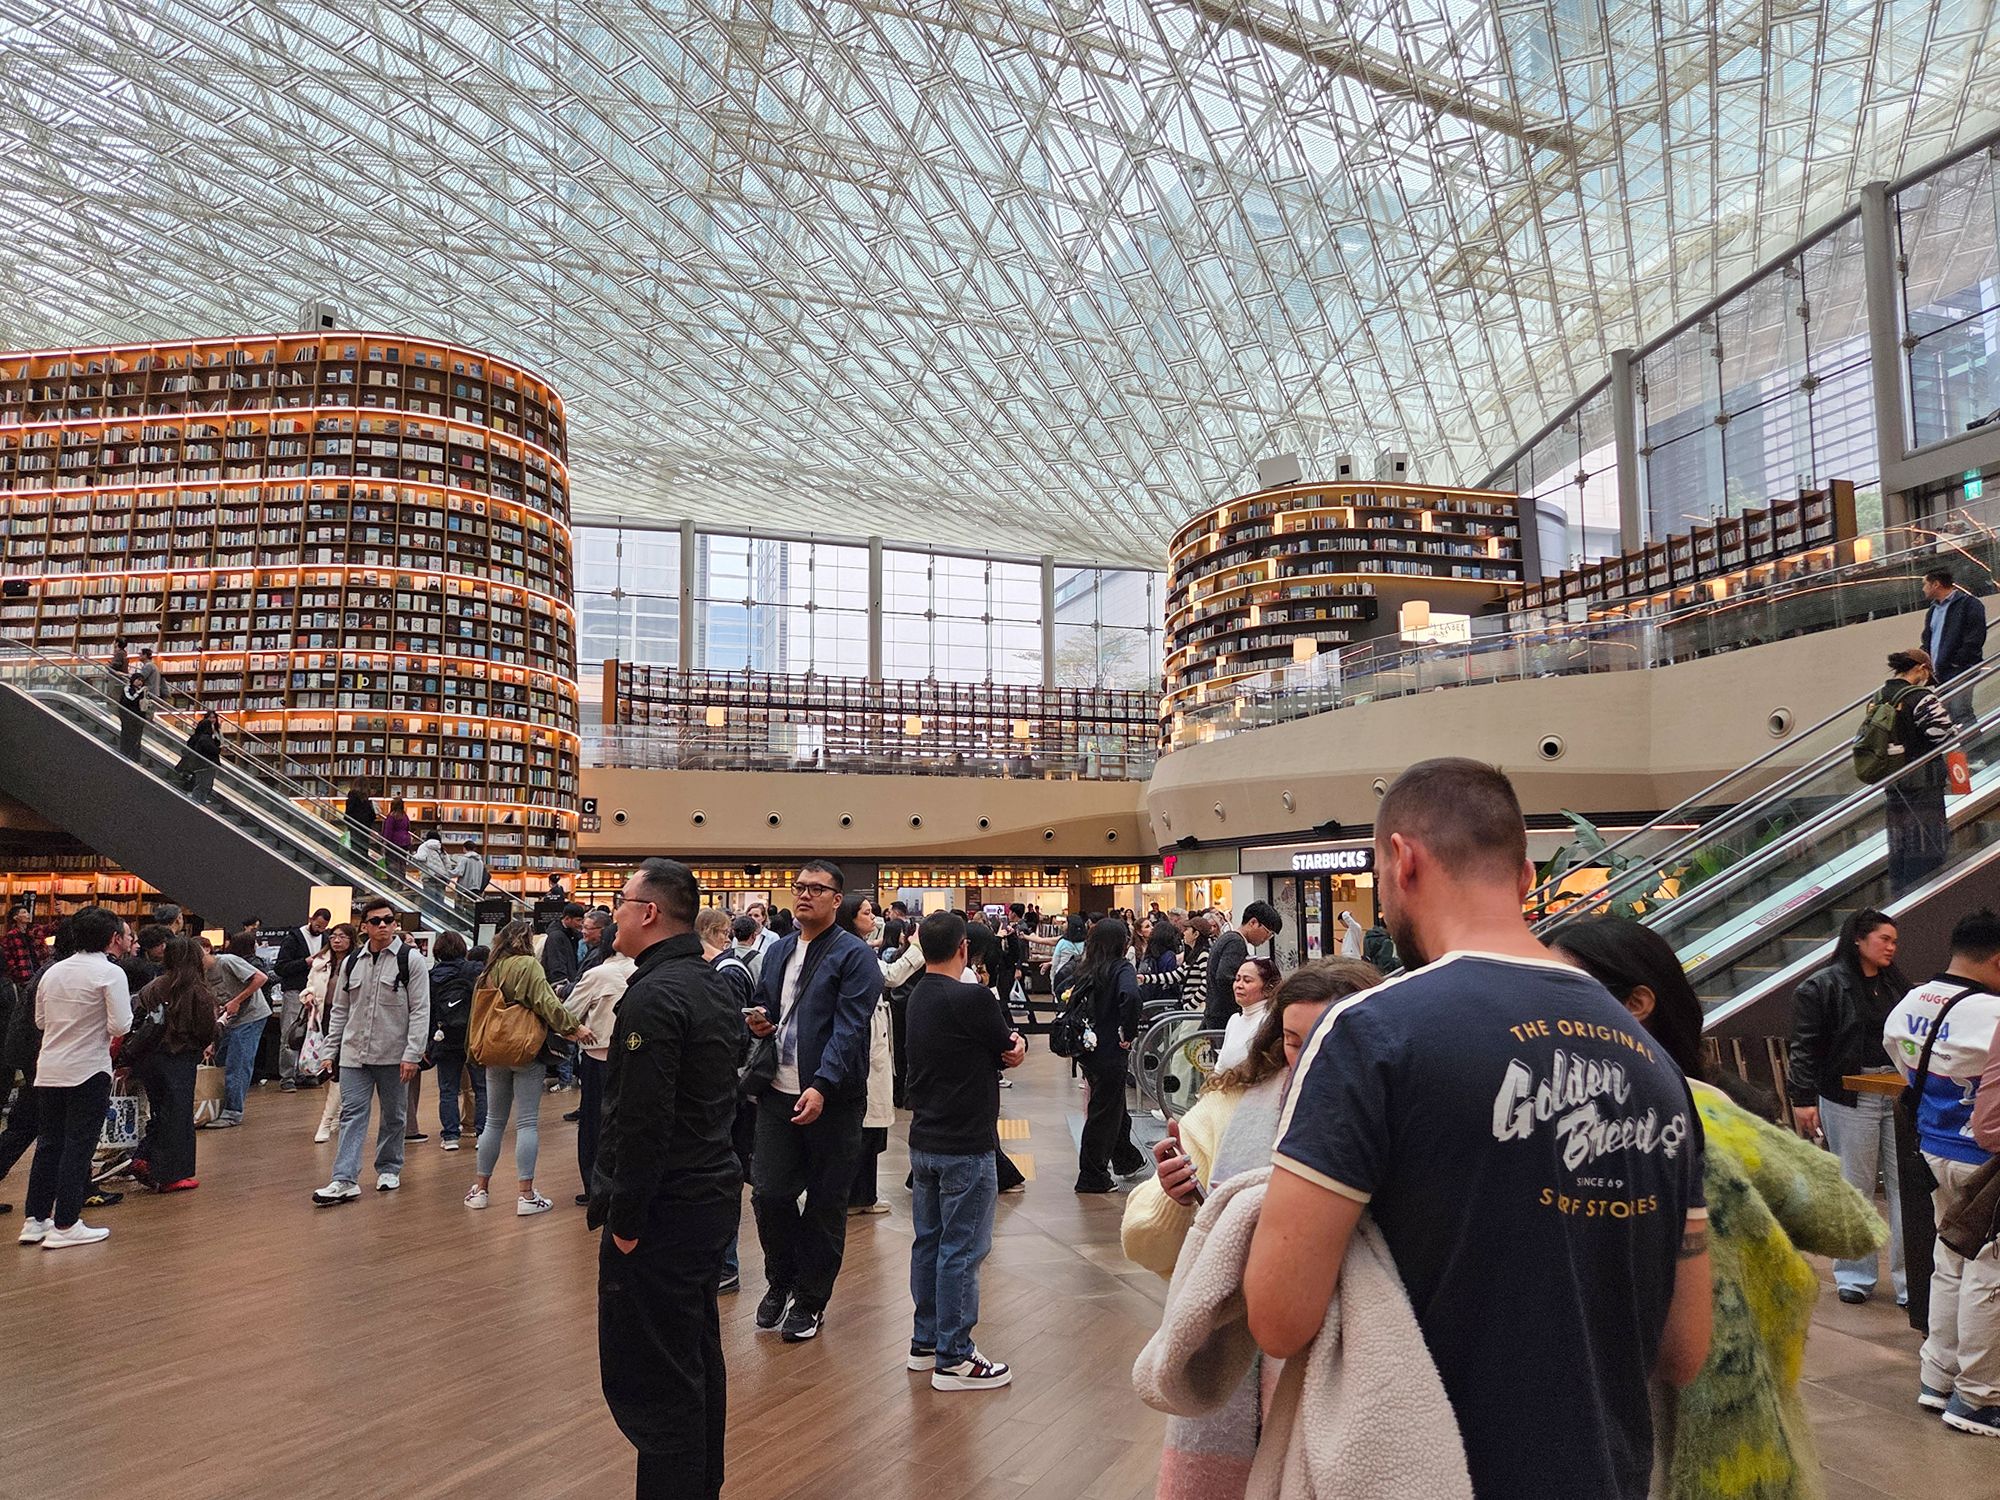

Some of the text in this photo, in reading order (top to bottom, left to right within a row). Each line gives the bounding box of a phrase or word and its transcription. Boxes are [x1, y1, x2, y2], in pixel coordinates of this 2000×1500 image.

[584, 800, 594, 812] C
[1292, 850, 1367, 871] STARBUCKS
[1906, 1013, 1949, 1041] VIA
[1510, 1019, 1655, 1064] THE ORIGINAL
[1492, 1048, 1631, 1142] Golden
[1556, 1100, 1661, 1172] Breed
[1576, 1177, 1624, 1188] SINCE 69
[1539, 1188, 1580, 1215] SRF
